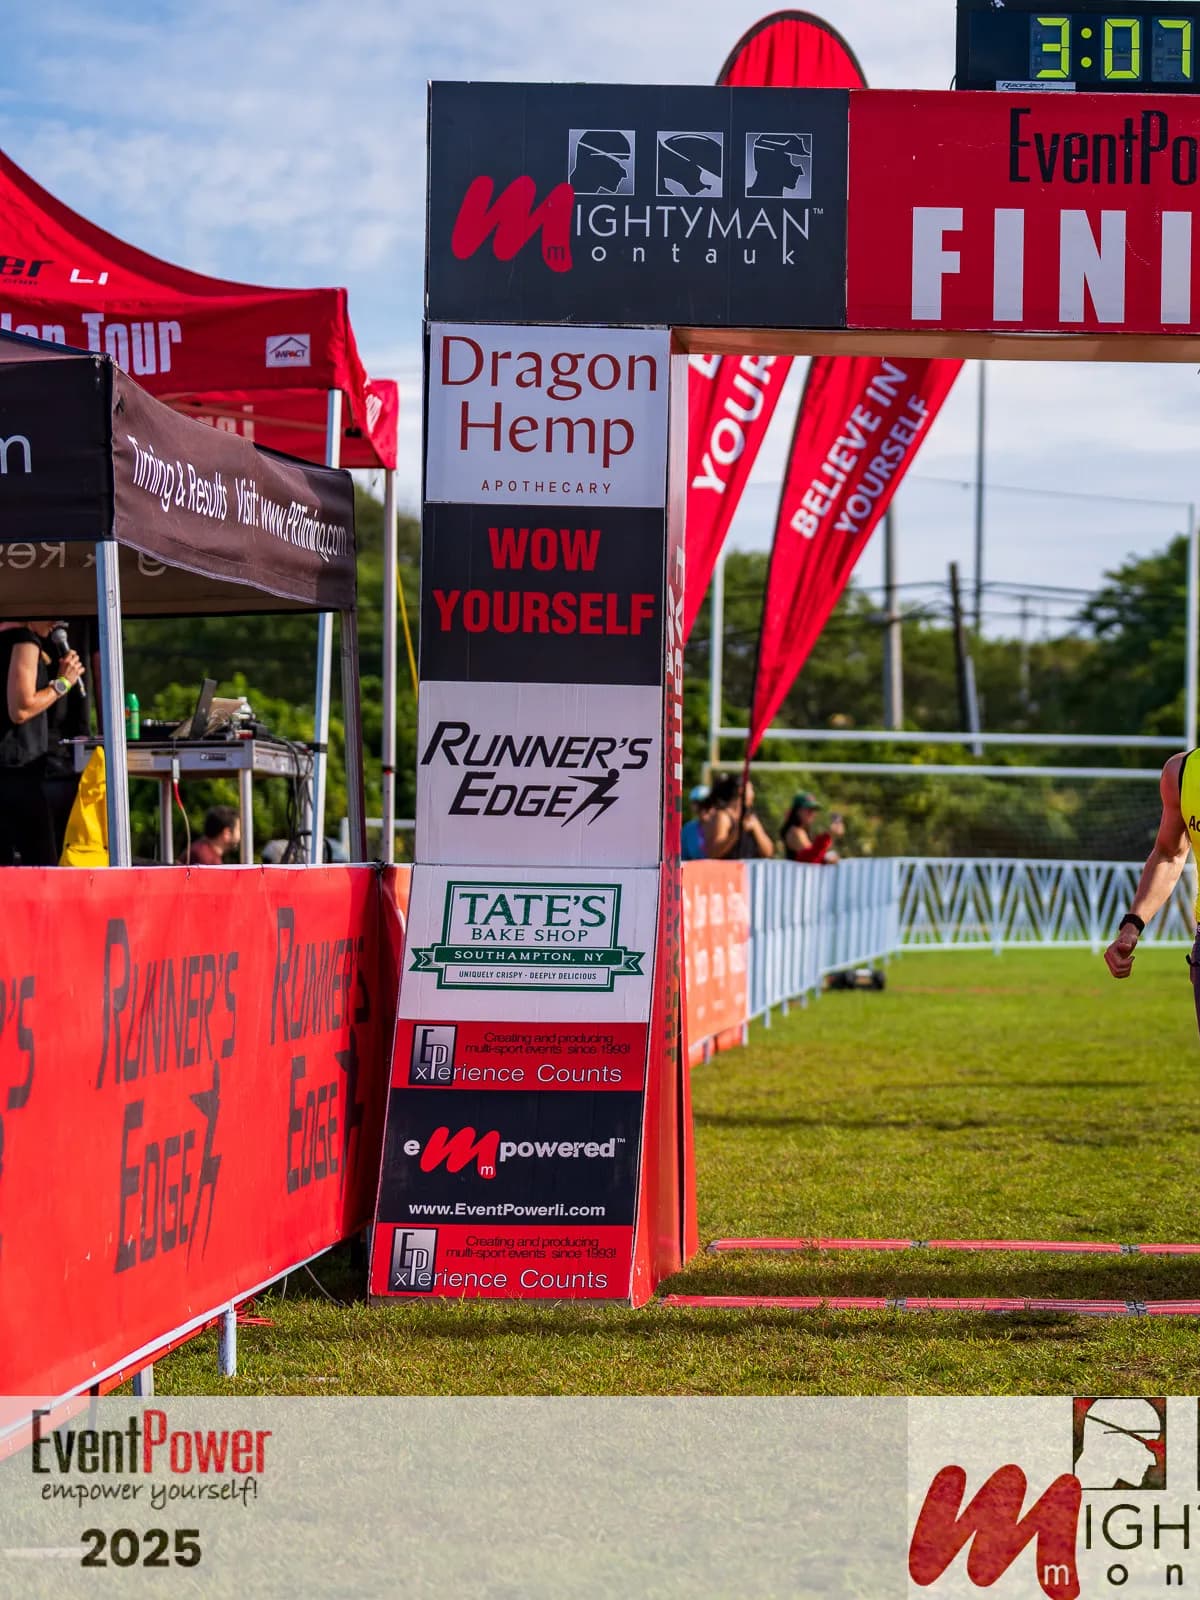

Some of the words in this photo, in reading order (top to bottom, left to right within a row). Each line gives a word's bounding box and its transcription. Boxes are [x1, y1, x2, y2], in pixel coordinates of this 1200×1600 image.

[82, 312, 182, 376] Tour
[441, 335, 658, 401] Dragon
[460, 400, 635, 469] Hemp
[790, 404, 882, 540] BELIEVE
[867, 360, 909, 407] IN
[127, 435, 175, 513] Timing
[175, 460, 186, 507] &
[187, 463, 228, 521] Results
[235, 478, 259, 528] Visit:
[481, 479, 612, 494] APOTHECARY
[833, 394, 931, 534] YOURSELF
[488, 527, 602, 572] WOW
[432, 589, 656, 636] YOURSELF
[420, 721, 653, 770] RUNNER'S
[448, 771, 579, 818] EDGE
[458, 893, 607, 928] TATE'S
[471, 928, 526, 942] BAKE
[535, 929, 588, 942] SHOP
[270, 907, 369, 1045] RUNNER'S
[459, 969, 494, 978] UNIQUELY
[496, 971, 523, 979] CRISPY
[584, 953, 605, 961] NY
[96, 918, 239, 1090] RUNNER'S
[537, 1063, 623, 1083] Counts
[286, 1055, 339, 1194] EDGE
[114, 1099, 196, 1274] EDGE
[520, 1269, 608, 1288] Counts
